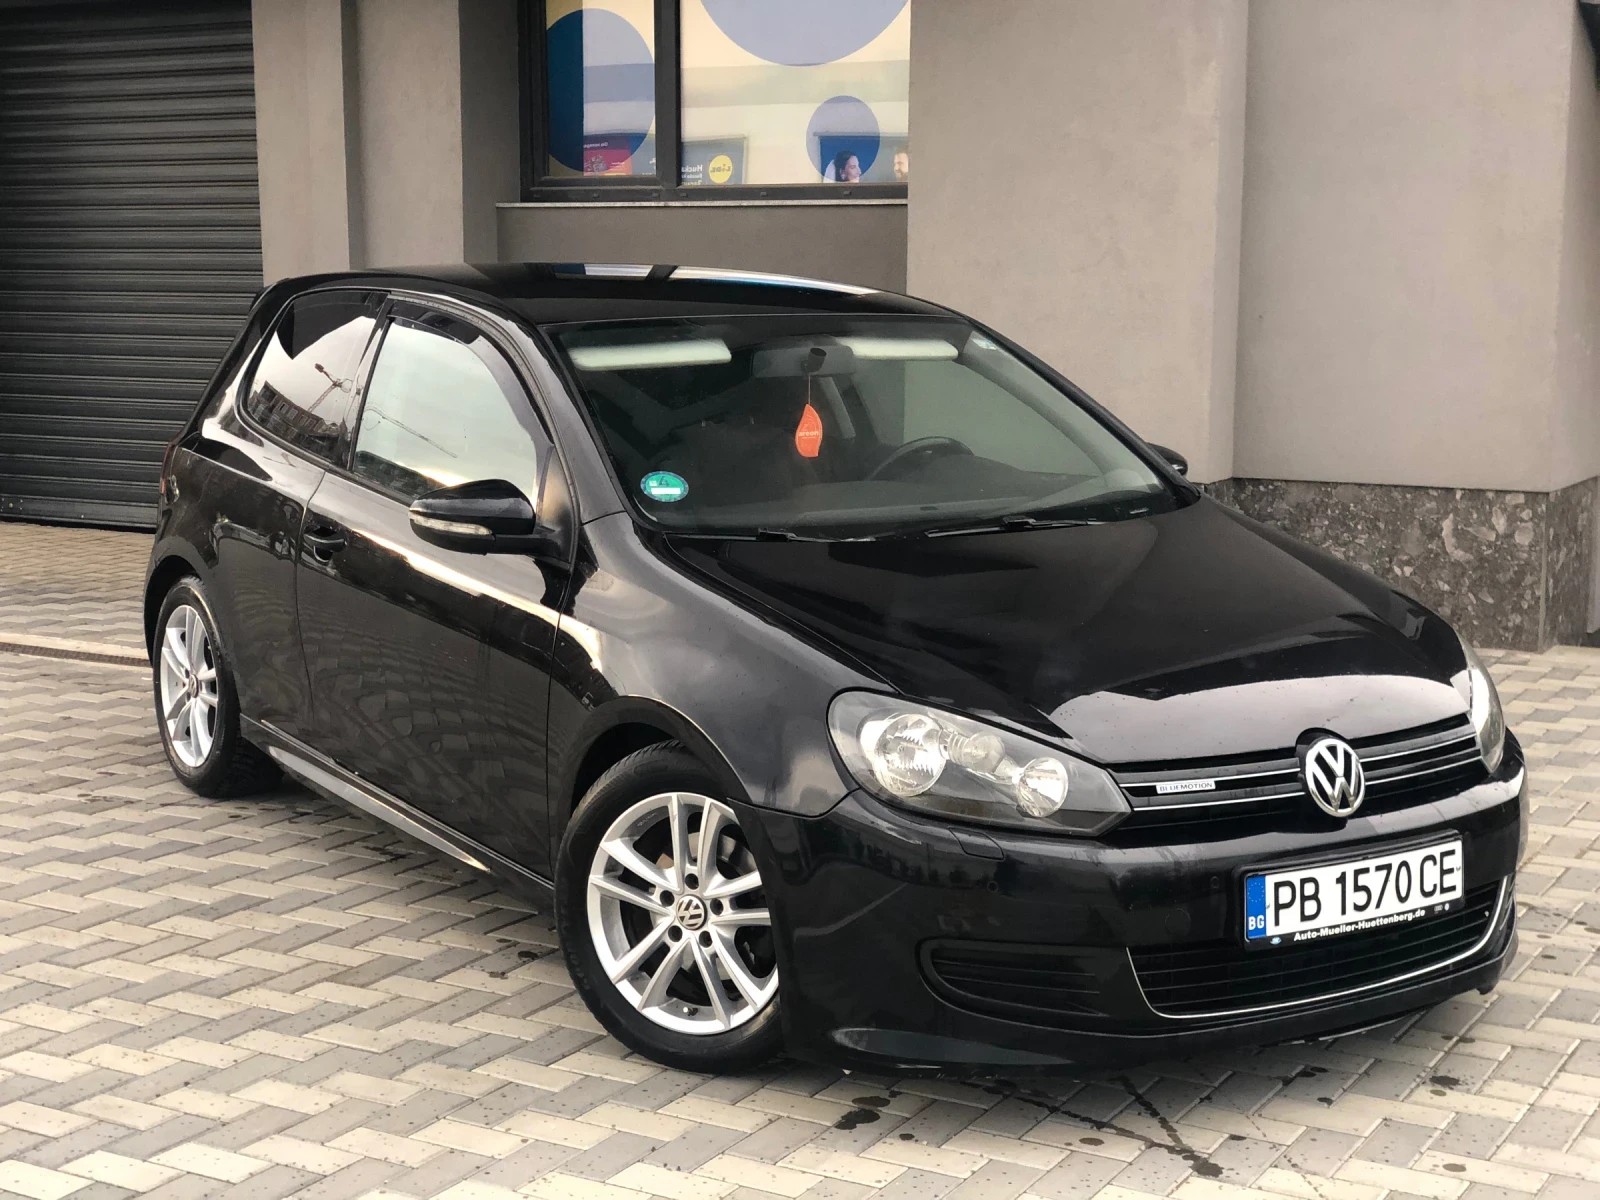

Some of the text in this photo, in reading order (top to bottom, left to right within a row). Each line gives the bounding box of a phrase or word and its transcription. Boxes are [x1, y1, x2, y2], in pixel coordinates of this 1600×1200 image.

[1159, 782, 1213, 792] BLUEMOTION
[1273, 849, 1457, 927] PB 1570 CE
[1248, 914, 1265, 931] BG
[1293, 908, 1426, 942] Auto-Mueller-Huettenberg.de
